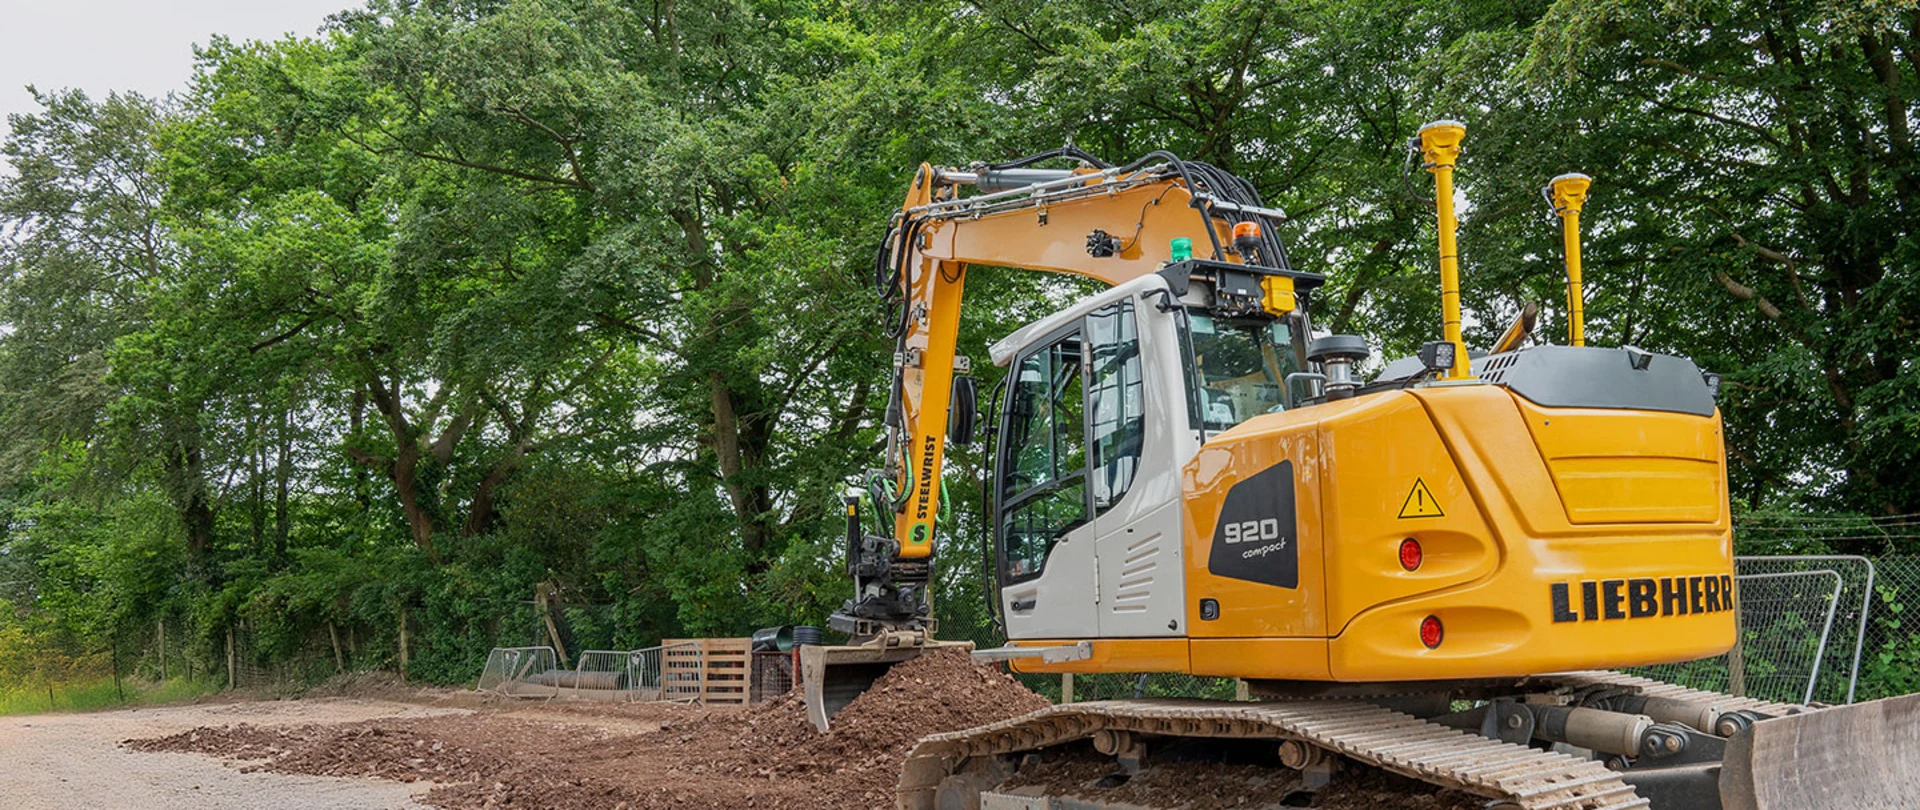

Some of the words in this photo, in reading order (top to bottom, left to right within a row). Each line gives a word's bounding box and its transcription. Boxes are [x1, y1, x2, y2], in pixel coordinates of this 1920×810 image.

[917, 435, 936, 519] STEELWRIST
[913, 524, 926, 542] S
[1224, 518, 1278, 544] 920
[1242, 537, 1287, 559] compact
[1551, 574, 1733, 623] LIEBHERR
